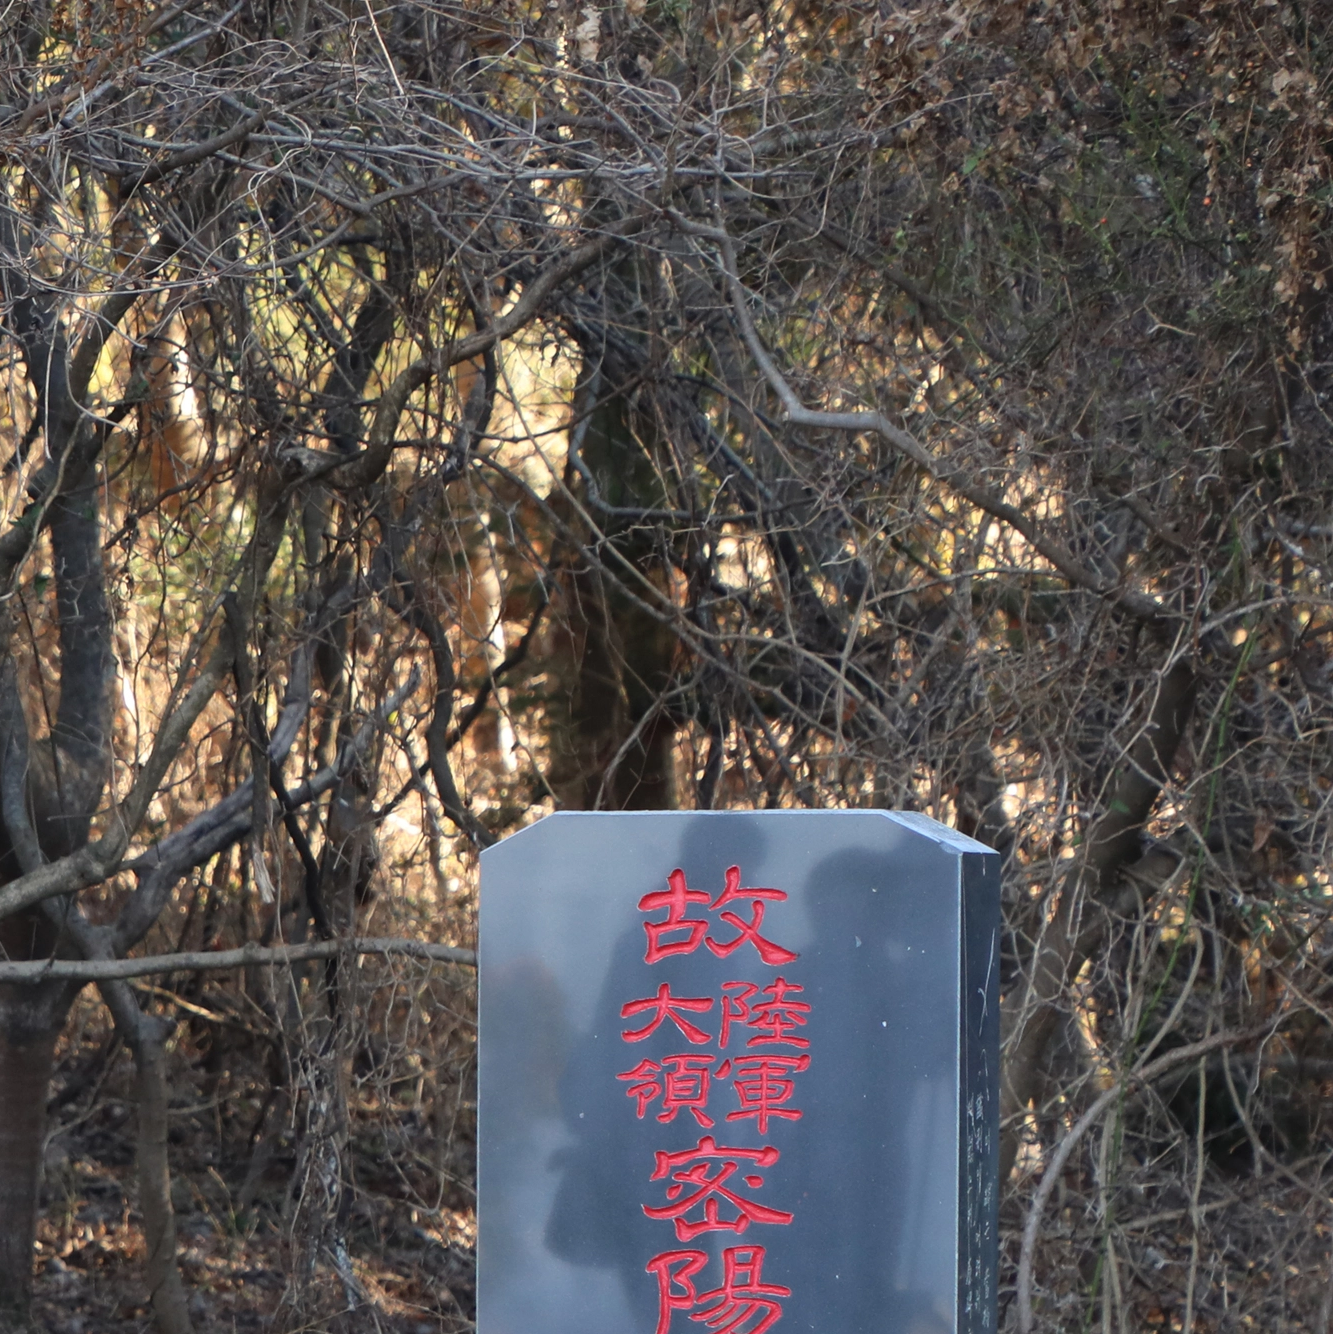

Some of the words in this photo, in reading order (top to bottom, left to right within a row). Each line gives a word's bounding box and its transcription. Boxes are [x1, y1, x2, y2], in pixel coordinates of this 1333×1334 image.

[638, 865, 797, 966] 故
[617, 983, 715, 1129] 大領
[715, 977, 811, 1135] 陸軍
